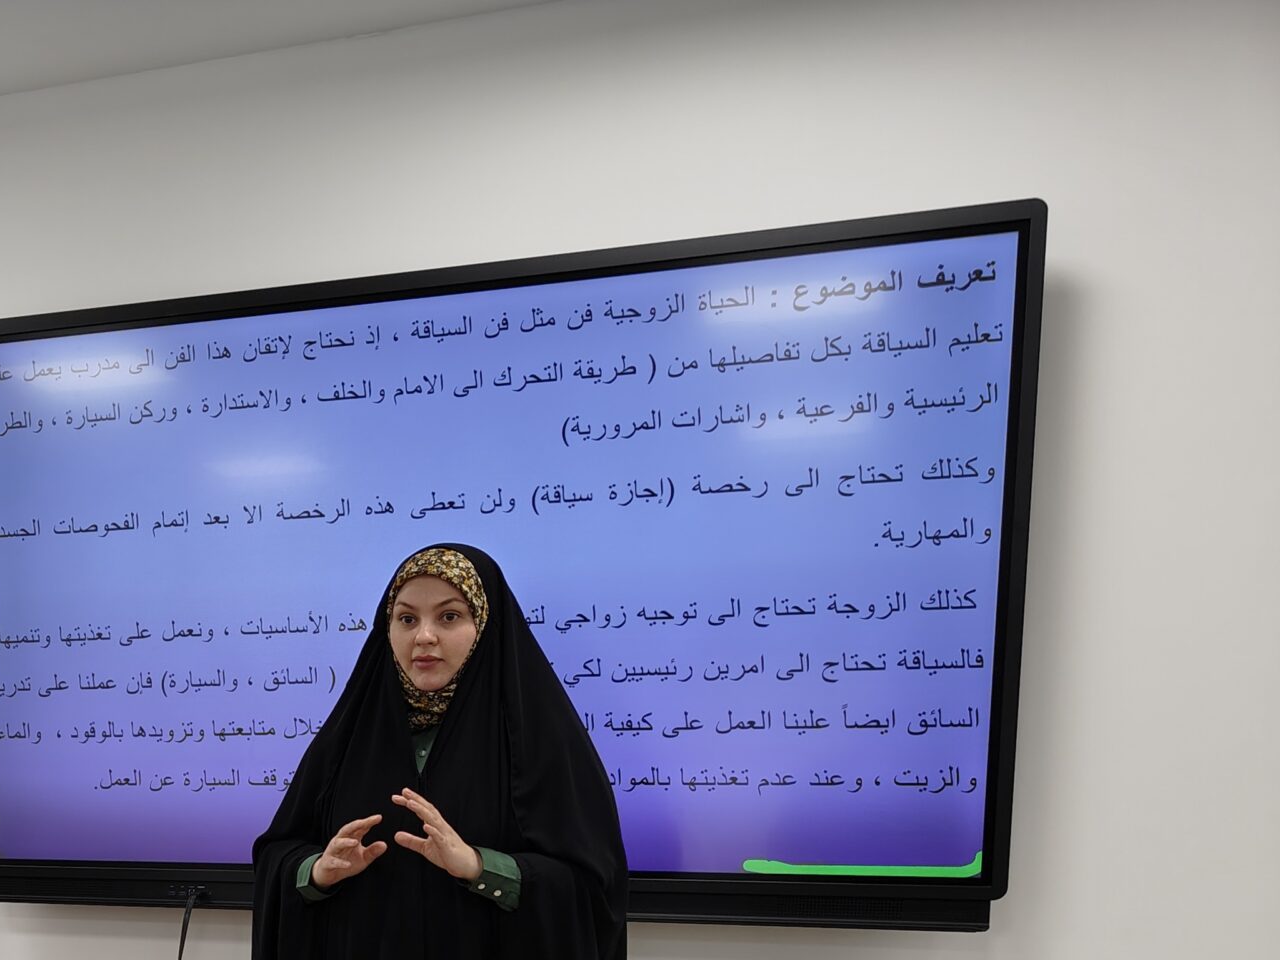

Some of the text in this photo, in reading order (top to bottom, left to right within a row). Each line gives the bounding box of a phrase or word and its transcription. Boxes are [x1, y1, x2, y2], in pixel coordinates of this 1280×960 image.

[918, 261, 996, 292] تعريف
[698, 286, 755, 315] الحياة
[793, 270, 903, 312] الموضوع
[520, 308, 556, 333] مثل
[567, 304, 593, 330] فن
[604, 293, 684, 325] الزوجية
[366, 325, 380, 350] إذ
[411, 316, 472, 343] السياقة
[484, 312, 509, 339] فن
[208, 341, 231, 359] هذا
[243, 335, 292, 363] لإتقان
[303, 331, 355, 360] نحتاج
[811, 336, 851, 362] بكل
[862, 327, 936, 358] السياقة
[949, 323, 1003, 356] تعليم
[71, 359, 120, 378] مدرب
[129, 348, 154, 375] الى
[165, 344, 195, 370] الفن
[573, 355, 637, 384] طريقة
[668, 357, 698, 378] من
[709, 342, 800, 373] تفاصيلها
[24, 360, 62, 382] يعمل
[453, 370, 483, 398] الى
[493, 362, 563, 392] التحرك
[317, 380, 385, 404] والخلف
[394, 374, 443, 404] الامام
[904, 382, 998, 415] الرئيسية
[66, 403, 120, 430] السيارة
[129, 400, 177, 425] وركن
[202, 390, 291, 418] والاستدارة
[796, 392, 894, 424] والفرعية
[672, 404, 766, 433] واشارات
[785, 468, 819, 497] الى
[838, 464, 903, 497] تحتاج
[922, 457, 995, 484] وكذلك
[692, 475, 768, 498] رخصة
[276, 498, 350, 524] الرخصة
[365, 496, 394, 515] هذه
[411, 492, 465, 519] تعطى
[480, 488, 515, 514] ولن
[54, 512, 139, 537] الفحوصات
[153, 510, 189, 536] إتمام
[204, 513, 229, 529] بعد
[243, 505, 262, 524] الا
[874, 517, 991, 548] والمهارية.
[708, 598, 741, 626] الى
[753, 598, 816, 628] تحتاج
[827, 591, 906, 620] الزوجة
[920, 589, 977, 611] كذلك
[240, 611, 328, 640] الأساسيات
[339, 613, 367, 632] هذه
[555, 605, 626, 634] زواجي
[637, 602, 697, 626] توجيه
[59, 624, 111, 647] تغذيتها
[119, 622, 151, 646] على
[162, 620, 213, 642] ونعمل
[563, 658, 601, 688] لكي
[611, 659, 693, 683] رئيسيين
[703, 655, 764, 681] امرين
[776, 652, 809, 681] الى
[822, 653, 886, 683] تحتاج
[897, 648, 984, 676] فالسياقة
[38, 674, 69, 698] على
[79, 673, 116, 690] عملنا
[126, 672, 152, 694] فإن
[264, 666, 317, 692] السائق
[71, 721, 123, 744] بالوقود
[131, 722, 205, 743] وتزويدها
[212, 720, 276, 742] متابعتها
[604, 712, 653, 737] كيفية
[662, 711, 703, 738] على
[716, 710, 771, 734] العمل
[783, 709, 829, 735] علينا
[843, 704, 895, 735] ايضاً
[907, 707, 979, 736] السائق
[94, 769, 141, 789] العمل.
[150, 774, 174, 792] عن
[183, 769, 240, 792] السيارة
[680, 766, 749, 792] تغذيتها
[758, 773, 796, 795] عدم
[809, 770, 862, 793] وعند
[894, 766, 977, 793] والزيت
